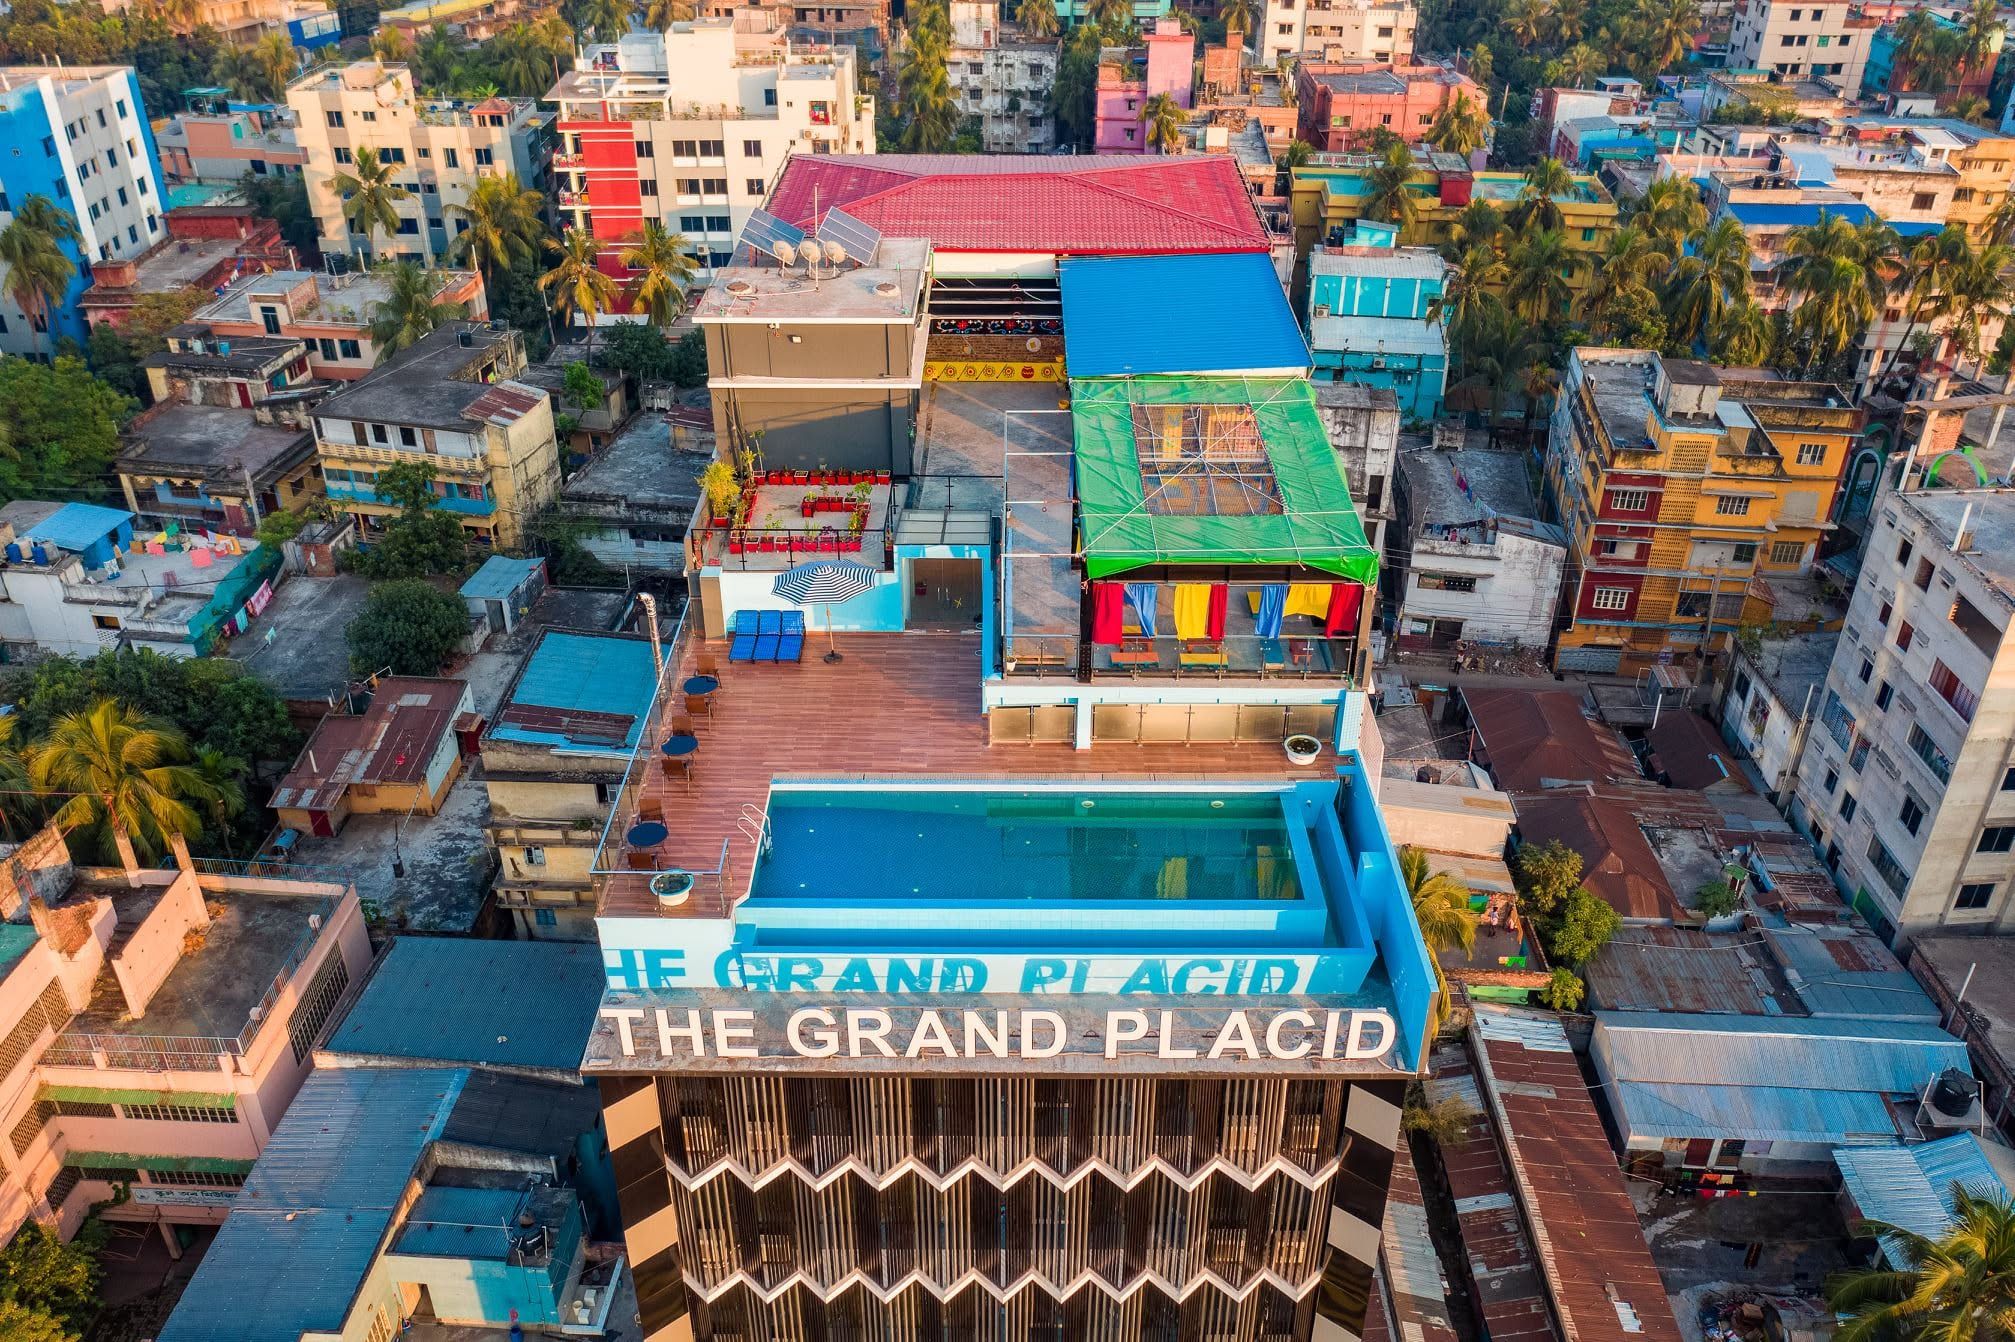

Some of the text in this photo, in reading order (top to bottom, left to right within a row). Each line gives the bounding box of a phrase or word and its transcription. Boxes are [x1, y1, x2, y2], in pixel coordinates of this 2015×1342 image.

[600, 1007, 1396, 1060] THE GRAND PLACID
